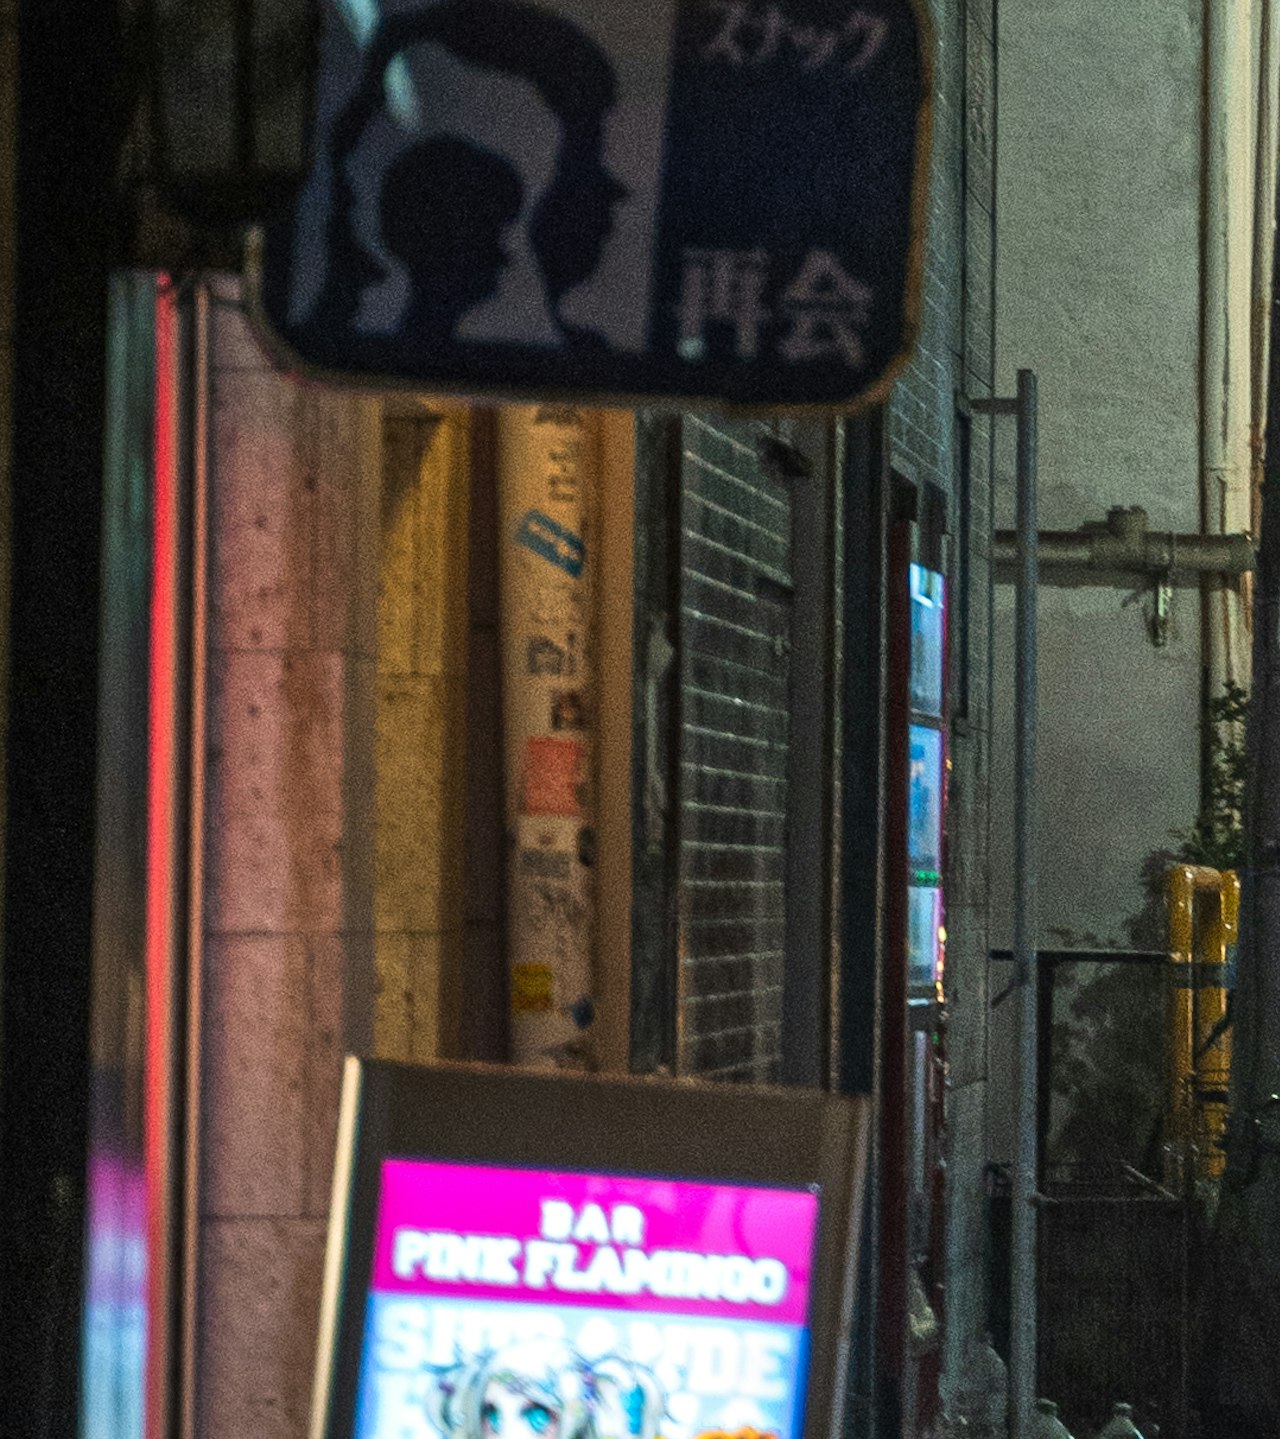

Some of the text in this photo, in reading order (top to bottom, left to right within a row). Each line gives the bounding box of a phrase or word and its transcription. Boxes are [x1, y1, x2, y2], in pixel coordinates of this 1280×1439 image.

[678, 248, 876, 366] 再会
[540, 1198, 645, 1247] BAR
[392, 1228, 788, 1305] PINK FLAMINGO
